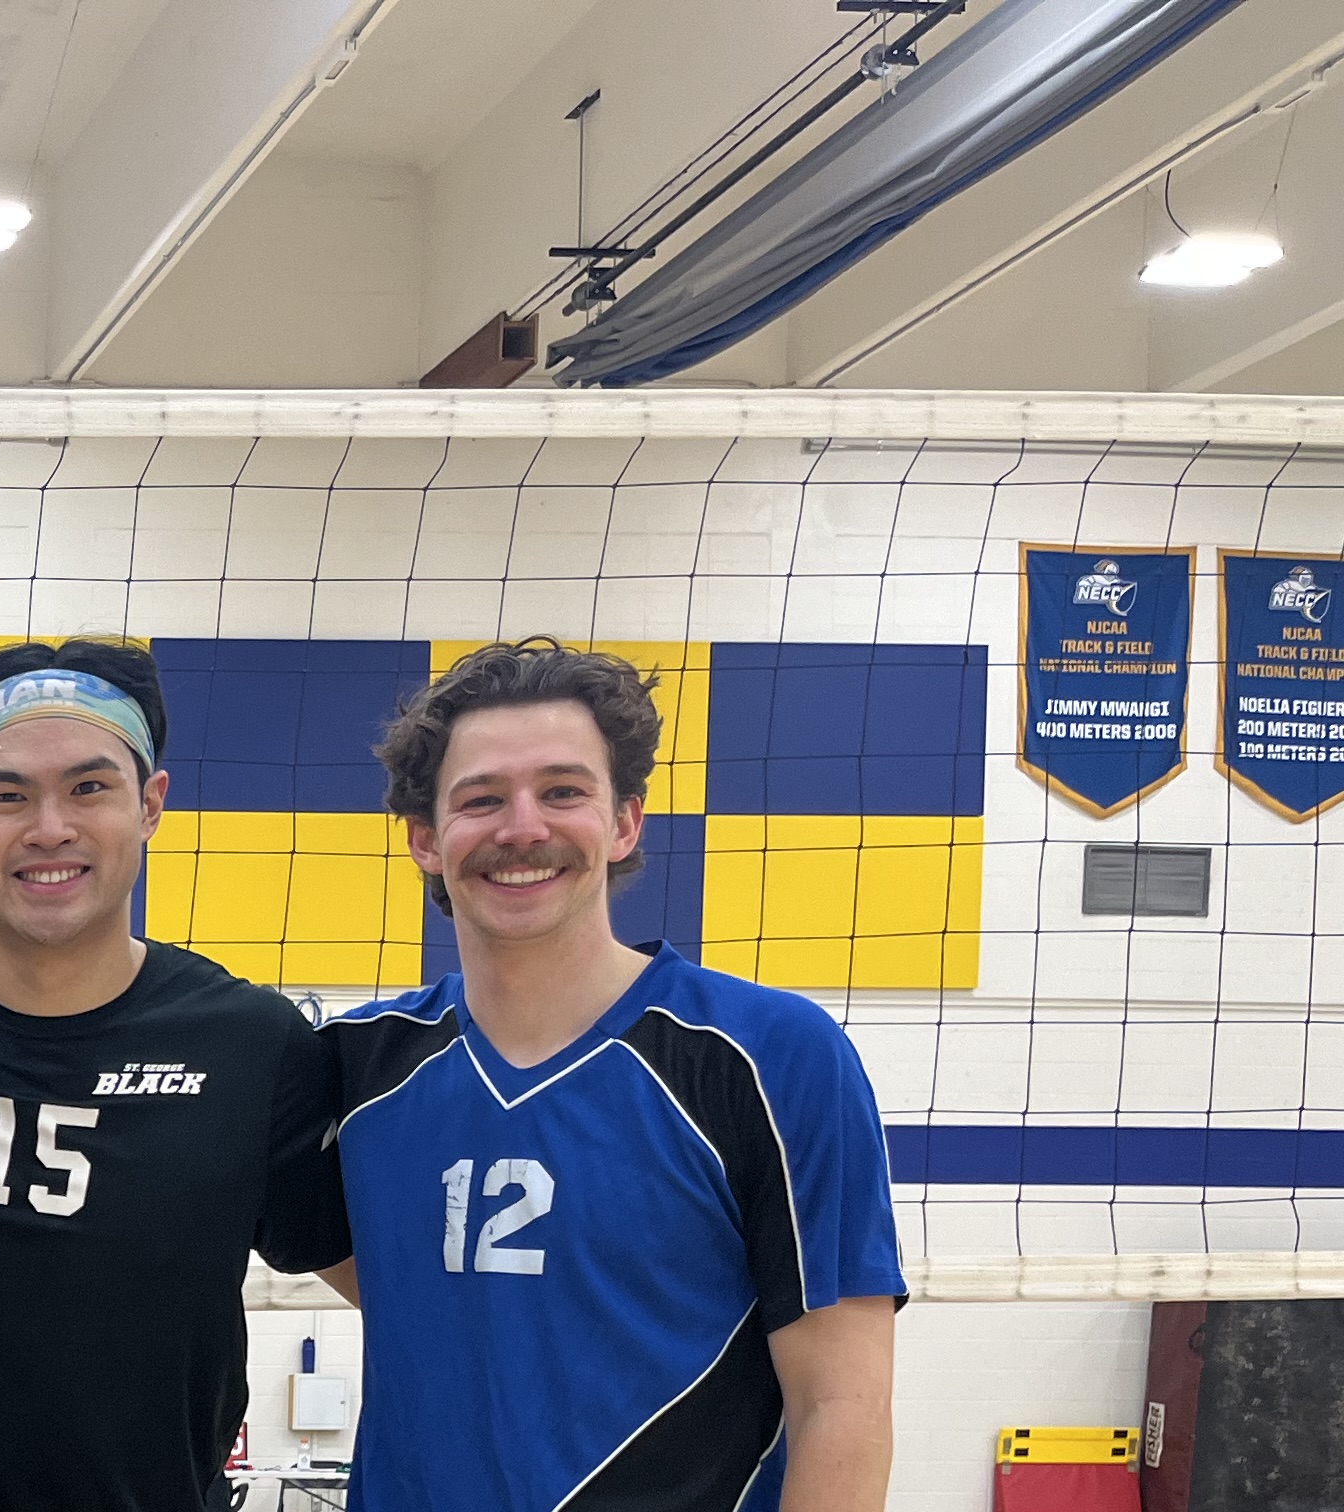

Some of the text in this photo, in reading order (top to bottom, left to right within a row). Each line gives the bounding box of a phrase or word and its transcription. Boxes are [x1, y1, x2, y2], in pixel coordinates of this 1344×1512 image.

[1077, 586, 1121, 601] NECC
[1272, 592, 1316, 607] NECC
[1087, 621, 1128, 635] NJCAA
[1283, 627, 1322, 641] NJCAA
[1059, 639, 1154, 655] TRACK & FIELD
[1257, 645, 1297, 660] TRACK
[1040, 658, 1177, 675] NATIONAL CHAMPION
[1237, 664, 1297, 679] NATIONAL
[1045, 698, 1170, 717] JIMMY MWANGI
[1239, 696, 1290, 715] NOELIA
[1037, 721, 1177, 740] 400 METERS 2006
[1237, 719, 1264, 736] 200
[1267, 721, 1326, 739] METERS
[1238, 742, 1264, 759] 100
[1267, 744, 1326, 762] METERS
[92, 1073, 207, 1095] BLACK
[441, 1158, 555, 1275] 12
